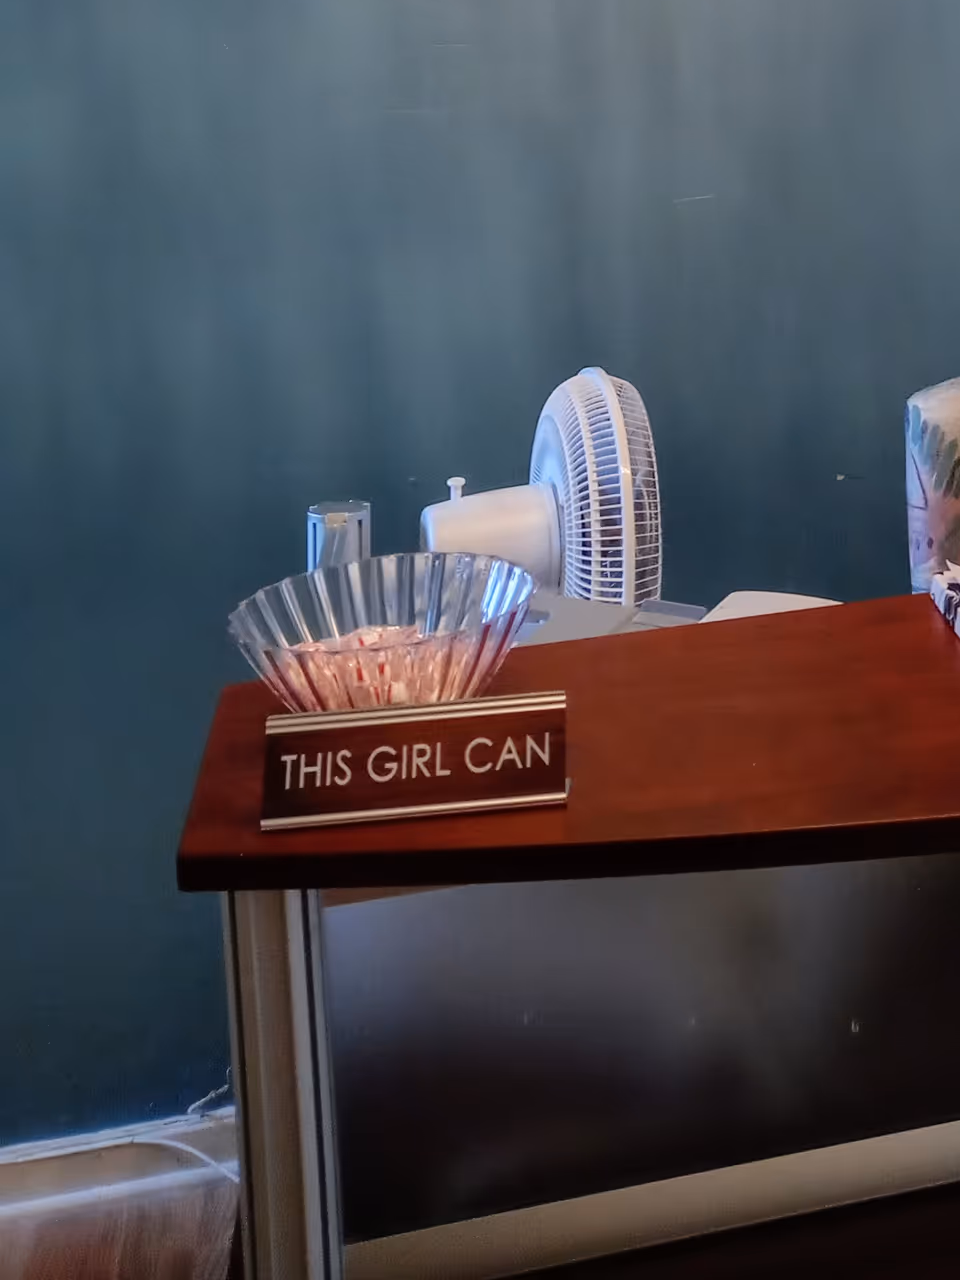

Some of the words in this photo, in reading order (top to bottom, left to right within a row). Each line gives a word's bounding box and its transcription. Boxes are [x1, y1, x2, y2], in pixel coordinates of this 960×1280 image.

[280, 750, 353, 790] THIS
[366, 742, 452, 783] GIRL
[464, 732, 551, 774] CAN
